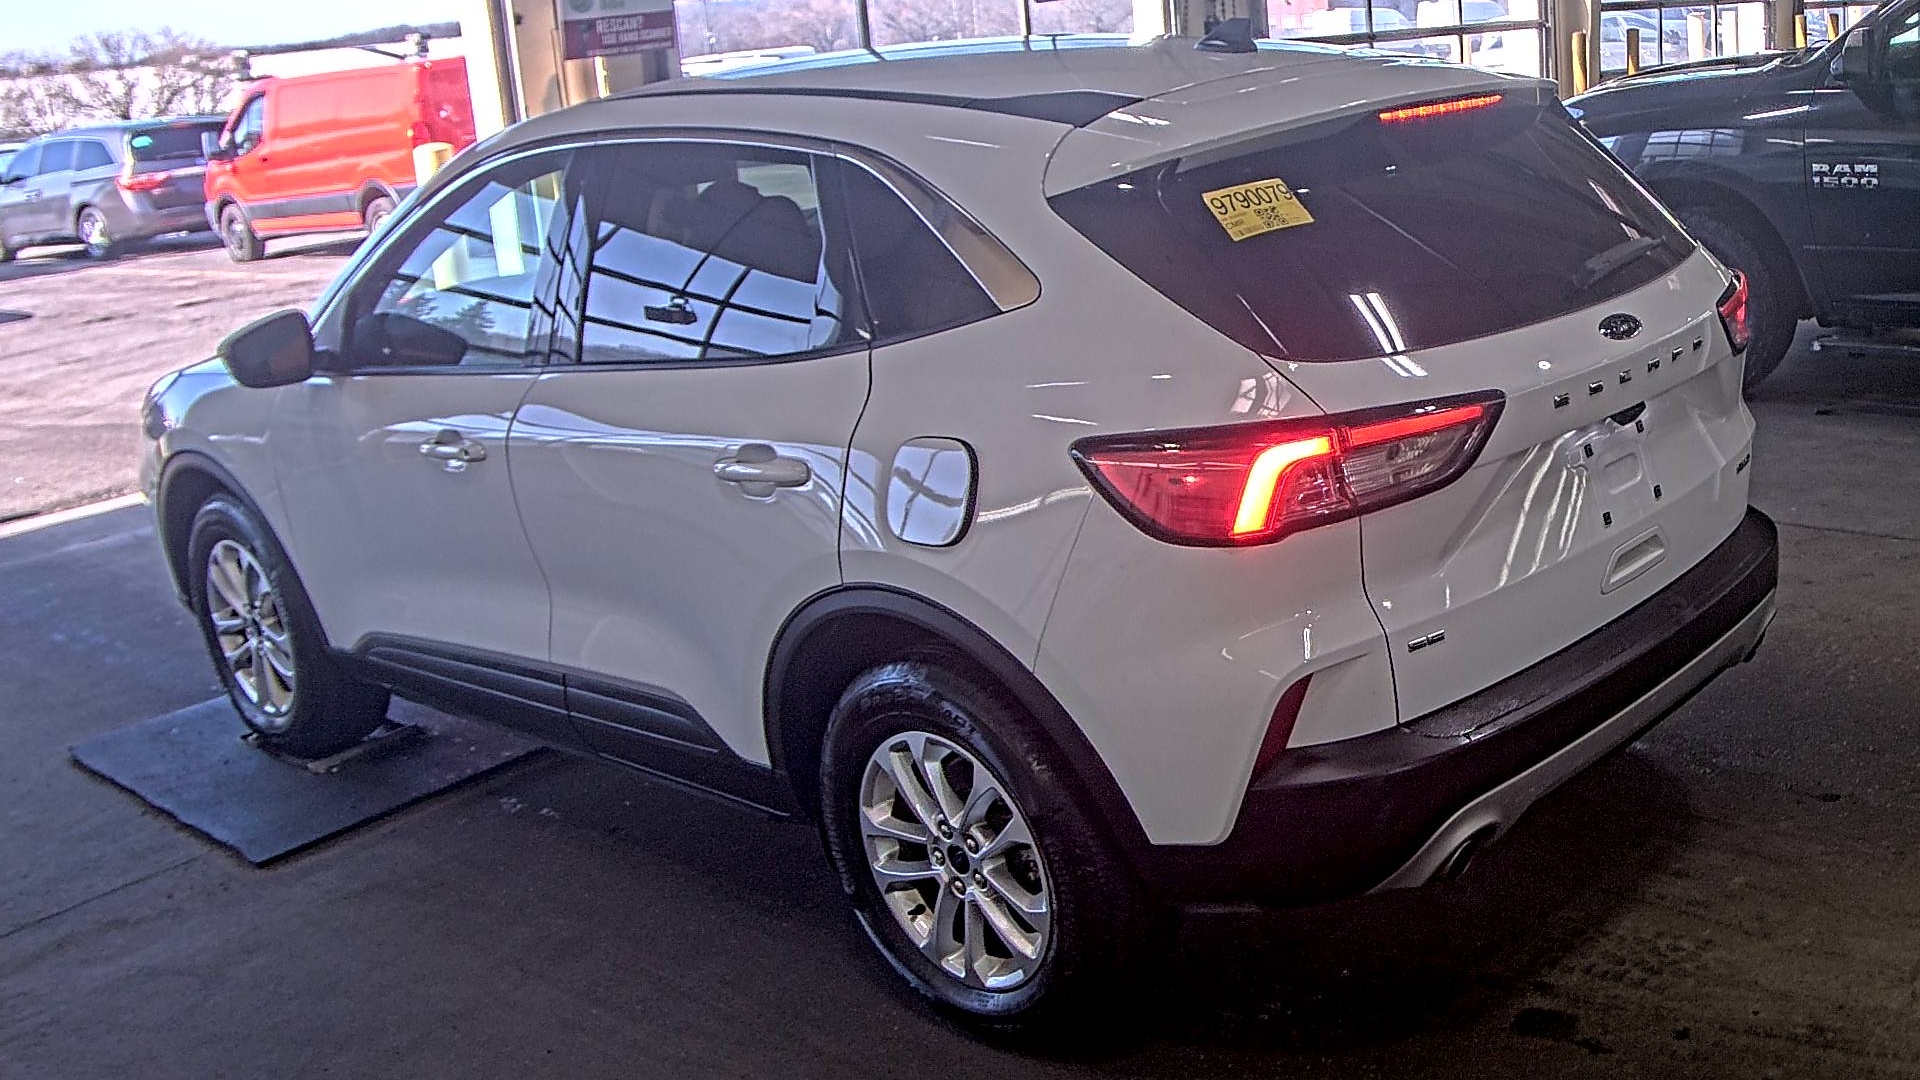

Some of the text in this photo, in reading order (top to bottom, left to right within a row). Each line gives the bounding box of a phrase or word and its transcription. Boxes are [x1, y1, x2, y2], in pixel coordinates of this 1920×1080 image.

[1812, 164, 1878, 175] RAM
[1813, 176, 1879, 188] 1500
[1210, 184, 1293, 215] 9790079
